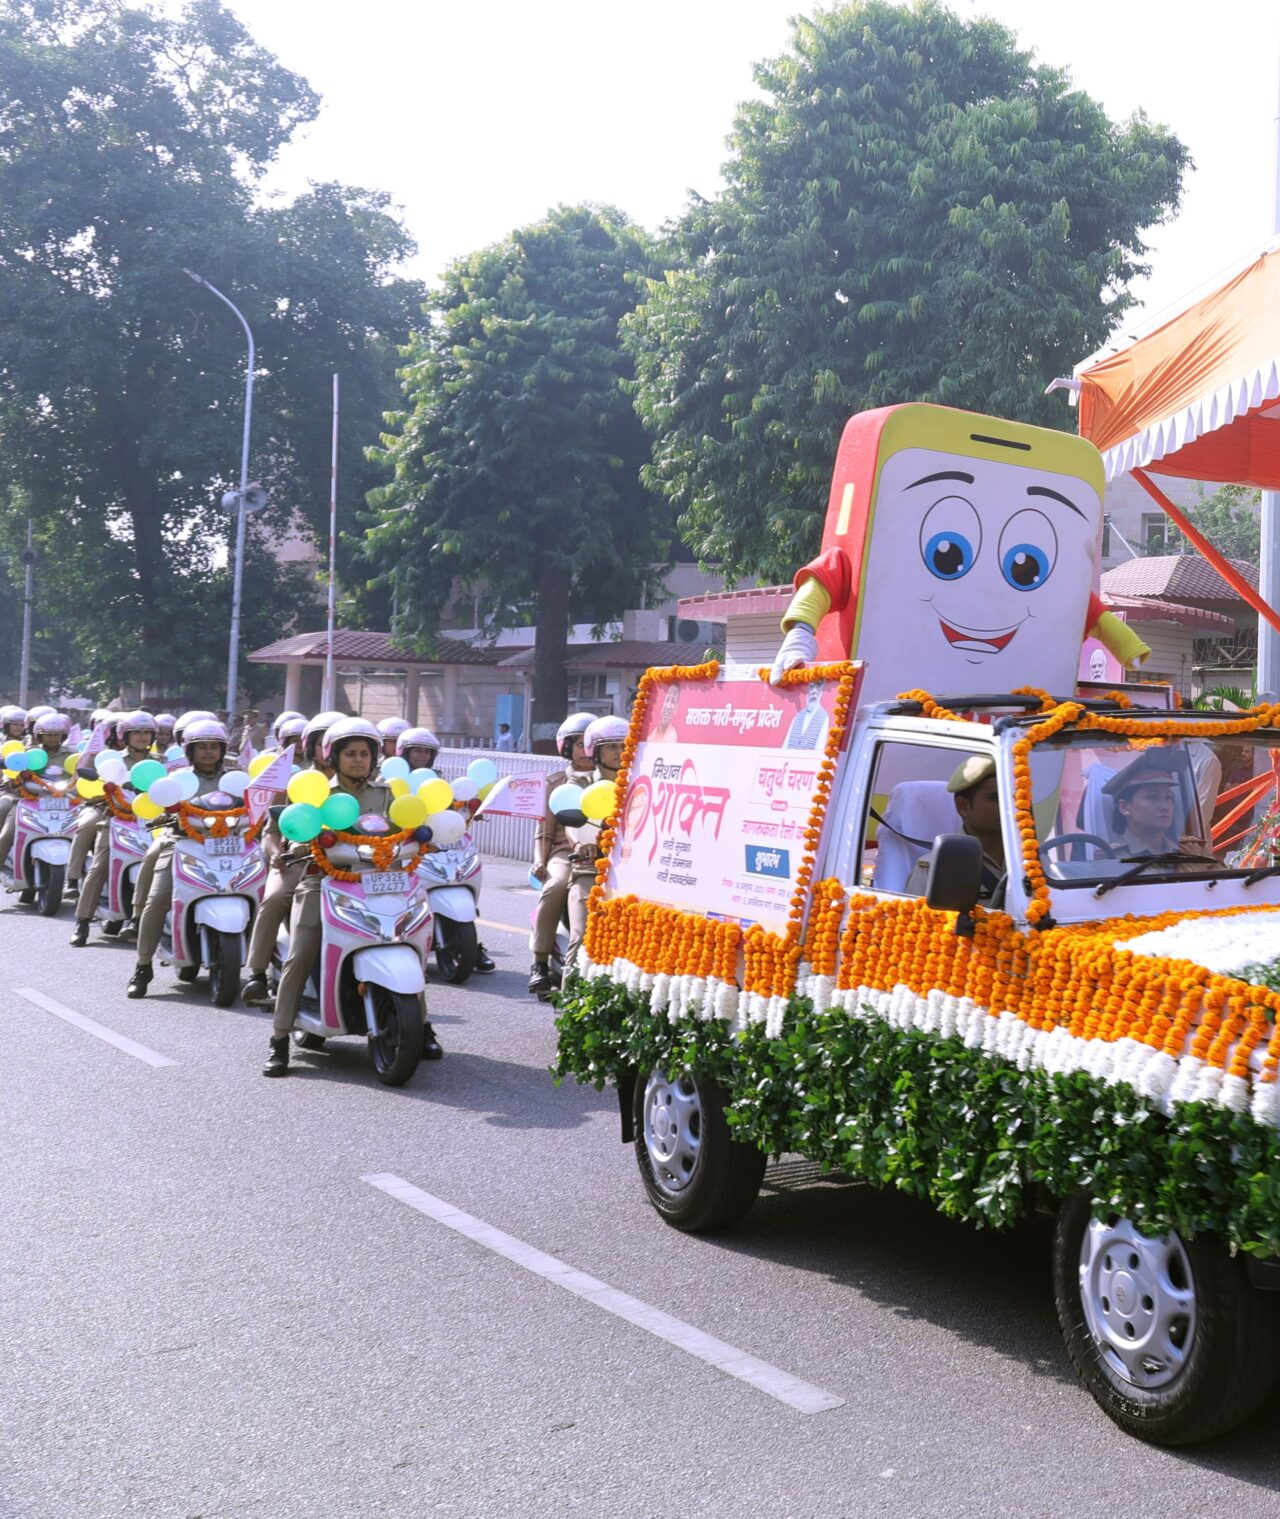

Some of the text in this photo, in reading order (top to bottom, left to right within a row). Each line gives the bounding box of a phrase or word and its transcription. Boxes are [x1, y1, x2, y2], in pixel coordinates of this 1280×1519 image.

[756, 703, 783, 728] प्रदेश
[652, 757, 681, 780] मिशन
[758, 762, 815, 797] चतुर्थ चरण
[648, 759, 731, 866] शक्ति
[370, 872, 405, 882] UP32E
[372, 882, 406, 893] G2477
